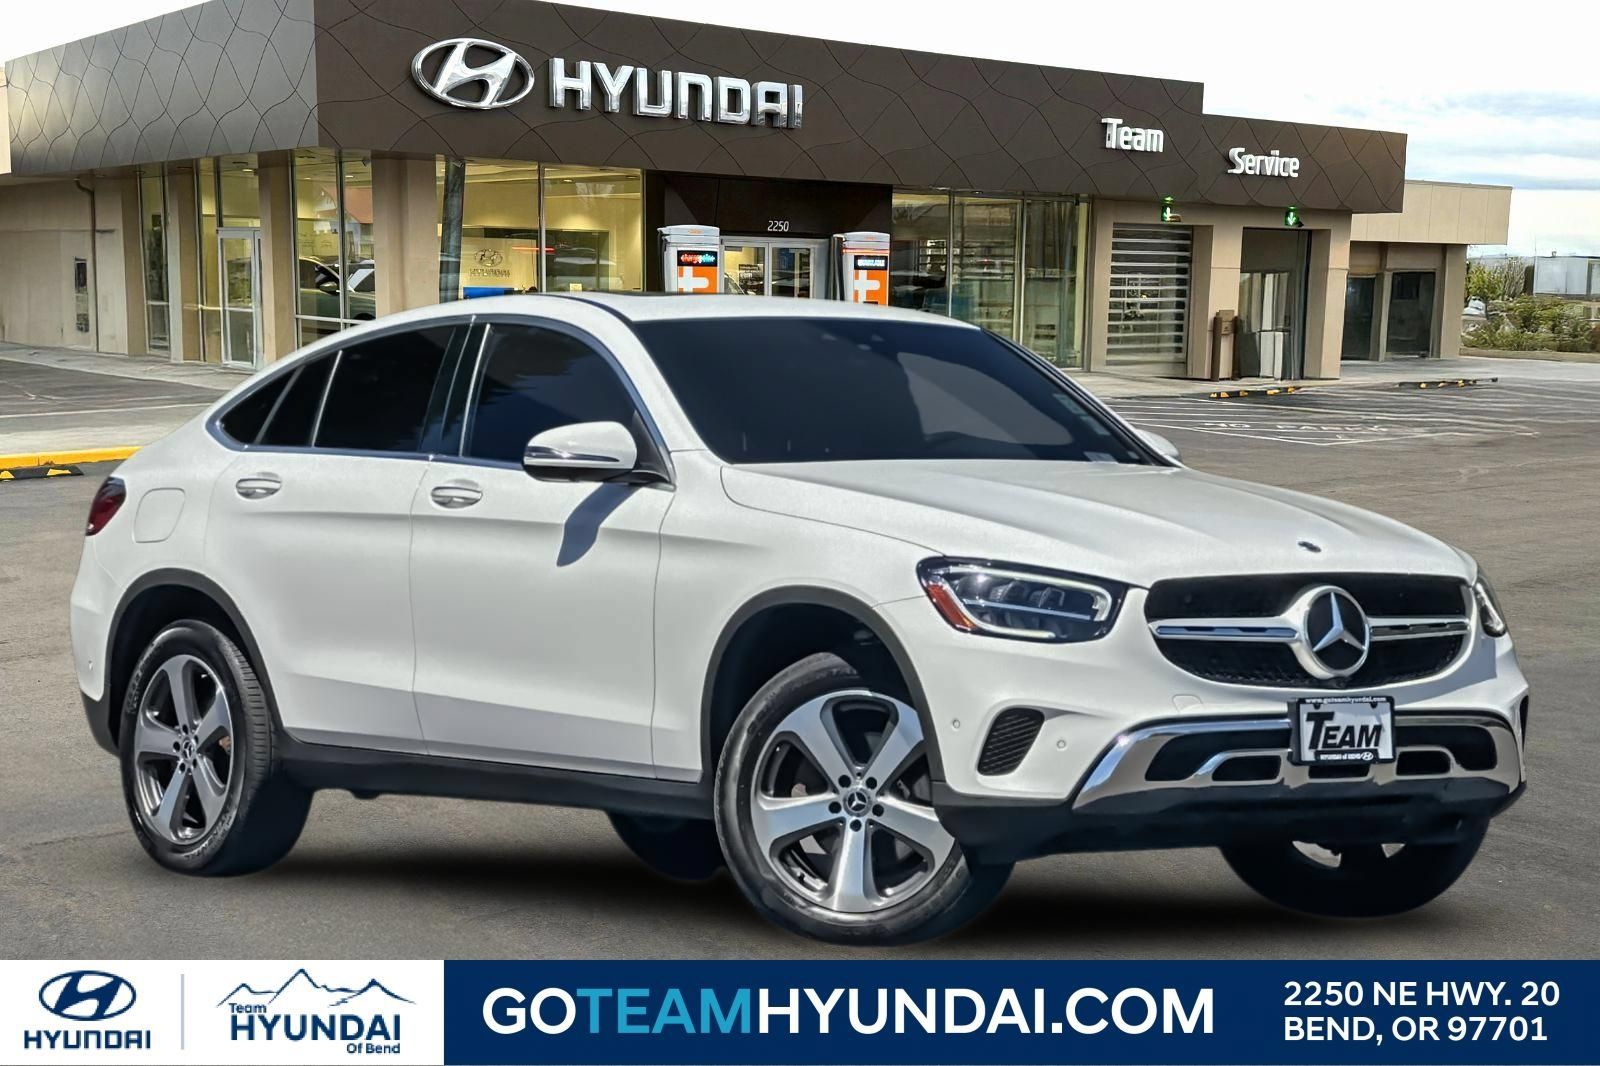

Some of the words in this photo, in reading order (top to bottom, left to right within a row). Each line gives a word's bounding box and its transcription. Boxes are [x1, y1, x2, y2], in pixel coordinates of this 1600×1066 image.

[549, 57, 803, 129] HYUNDAI
[1101, 118, 1164, 152] Team
[1227, 147, 1300, 178] Service
[767, 220, 790, 232] 2250
[1306, 711, 1383, 749] TEAM
